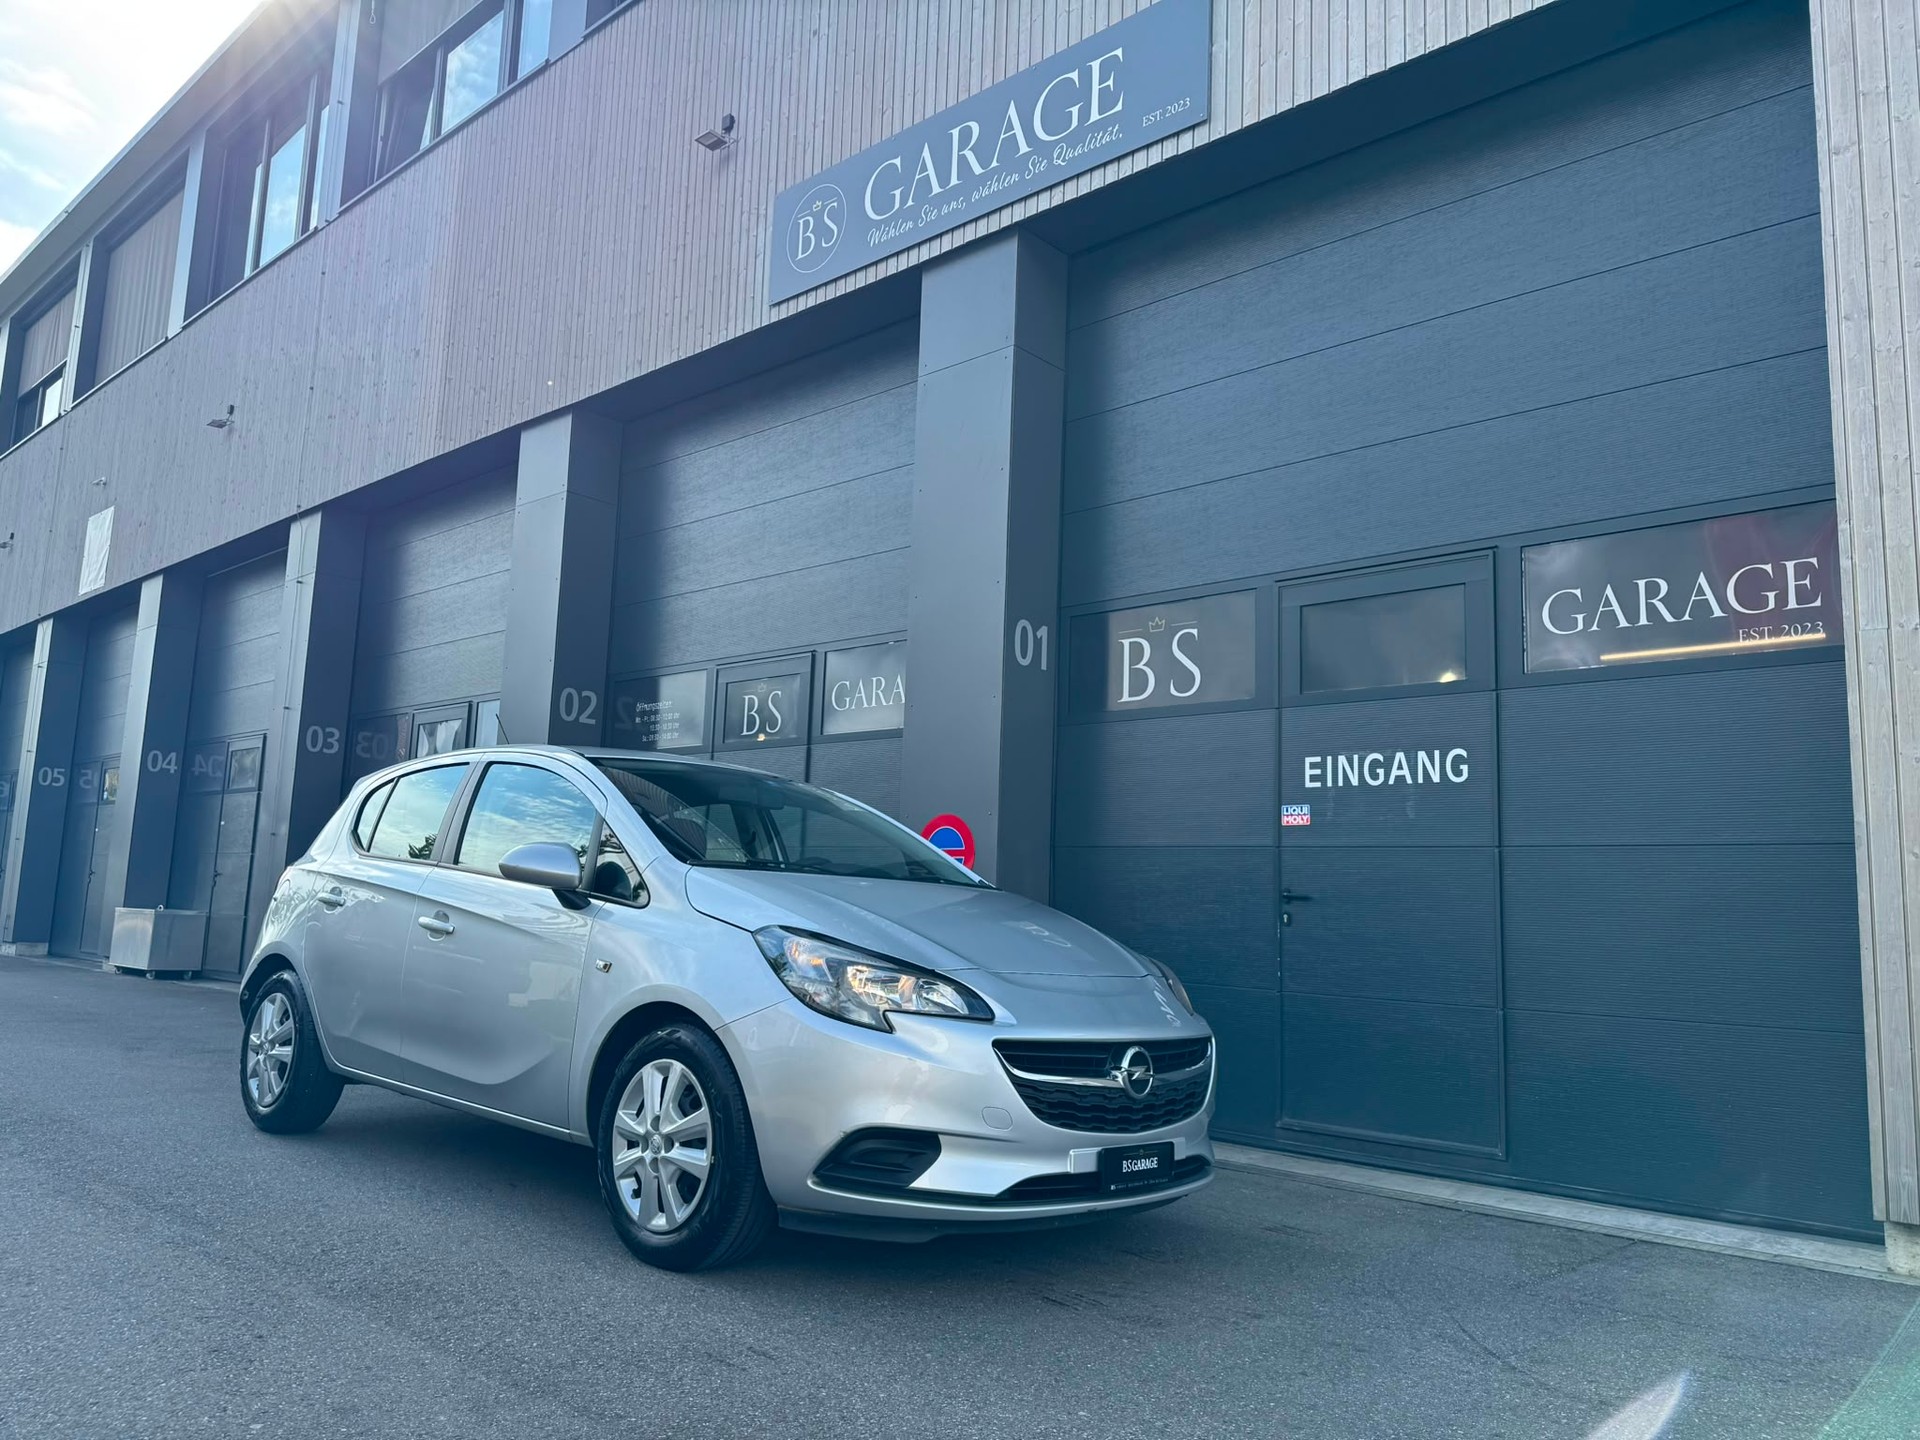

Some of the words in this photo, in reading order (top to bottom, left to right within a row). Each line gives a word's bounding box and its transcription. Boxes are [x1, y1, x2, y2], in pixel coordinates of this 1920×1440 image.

[1142, 109, 1163, 127] EST.
[1165, 97, 1191, 118] 2023
[863, 47, 1124, 220] GARAGE
[867, 218, 914, 247] Wählen
[918, 204, 939, 227] Sie
[941, 196, 966, 216] uns,
[971, 171, 1020, 202] wählen
[1025, 155, 1048, 180] Sie
[1053, 123, 1123, 166] Qualität.
[1541, 557, 1822, 635] GARAGE
[1014, 619, 1049, 671] 01
[1738, 625, 1776, 643] EST.
[1779, 621, 1824, 639] 2023
[559, 687, 598, 725] 02
[305, 725, 340, 754] 03
[38, 767, 65, 787] 05
[147, 750, 178, 774] 04
[1304, 748, 1469, 788] EINGANG
[1283, 806, 1308, 815] LIQUI
[1283, 815, 1309, 824] MOLY
